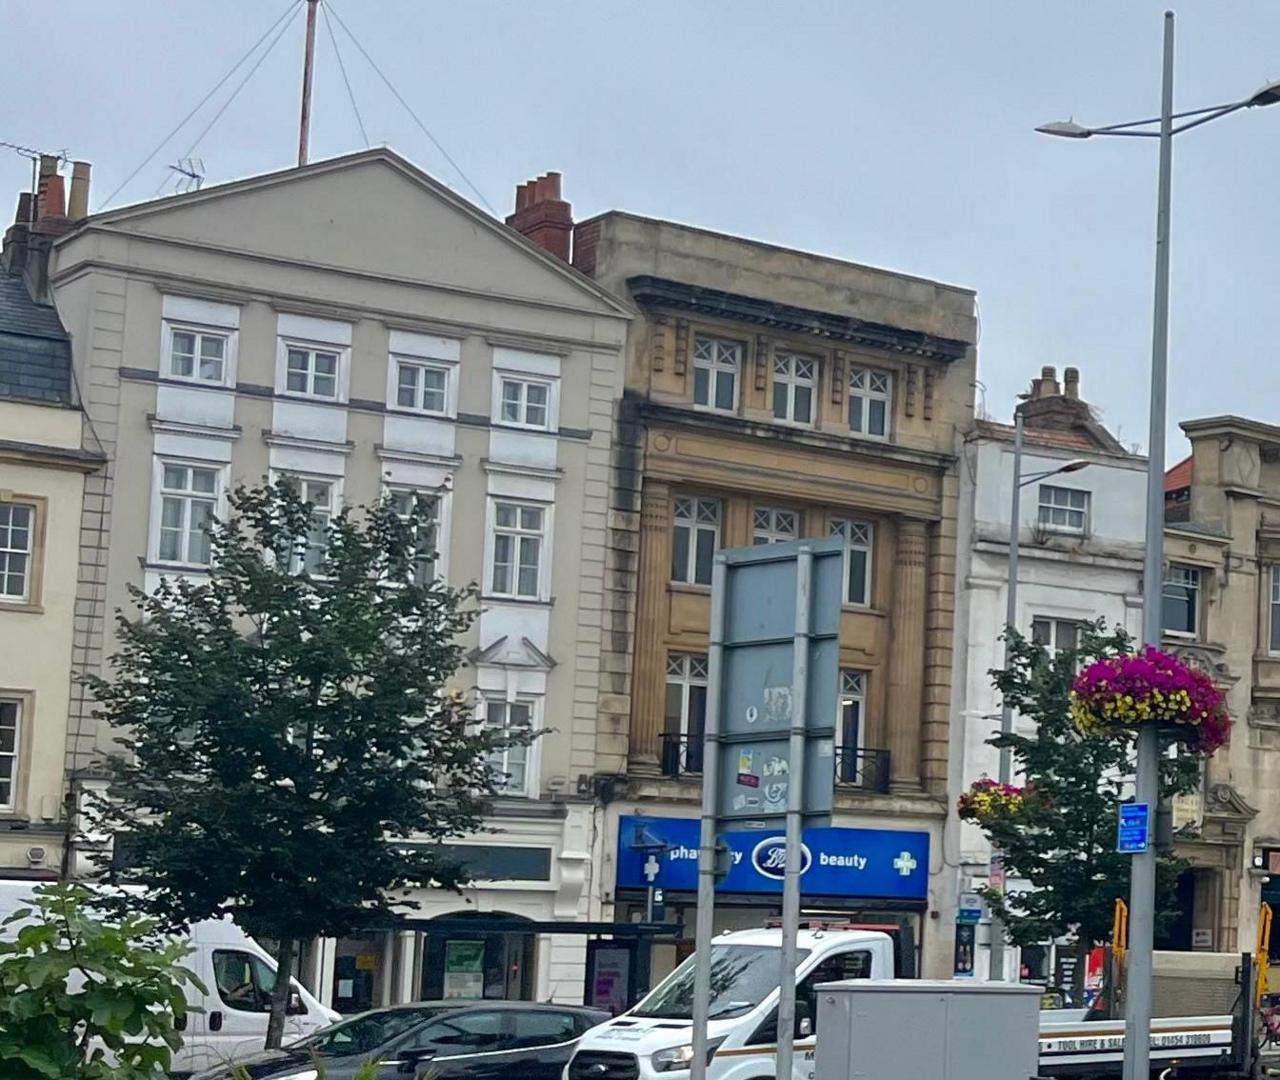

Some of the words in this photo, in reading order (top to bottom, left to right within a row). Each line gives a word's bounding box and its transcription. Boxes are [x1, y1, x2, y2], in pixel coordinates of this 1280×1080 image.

[820, 852, 867, 870] beauty
[1058, 1041, 1077, 1050] TOOL
[1079, 1040, 1097, 1049] HIRE
